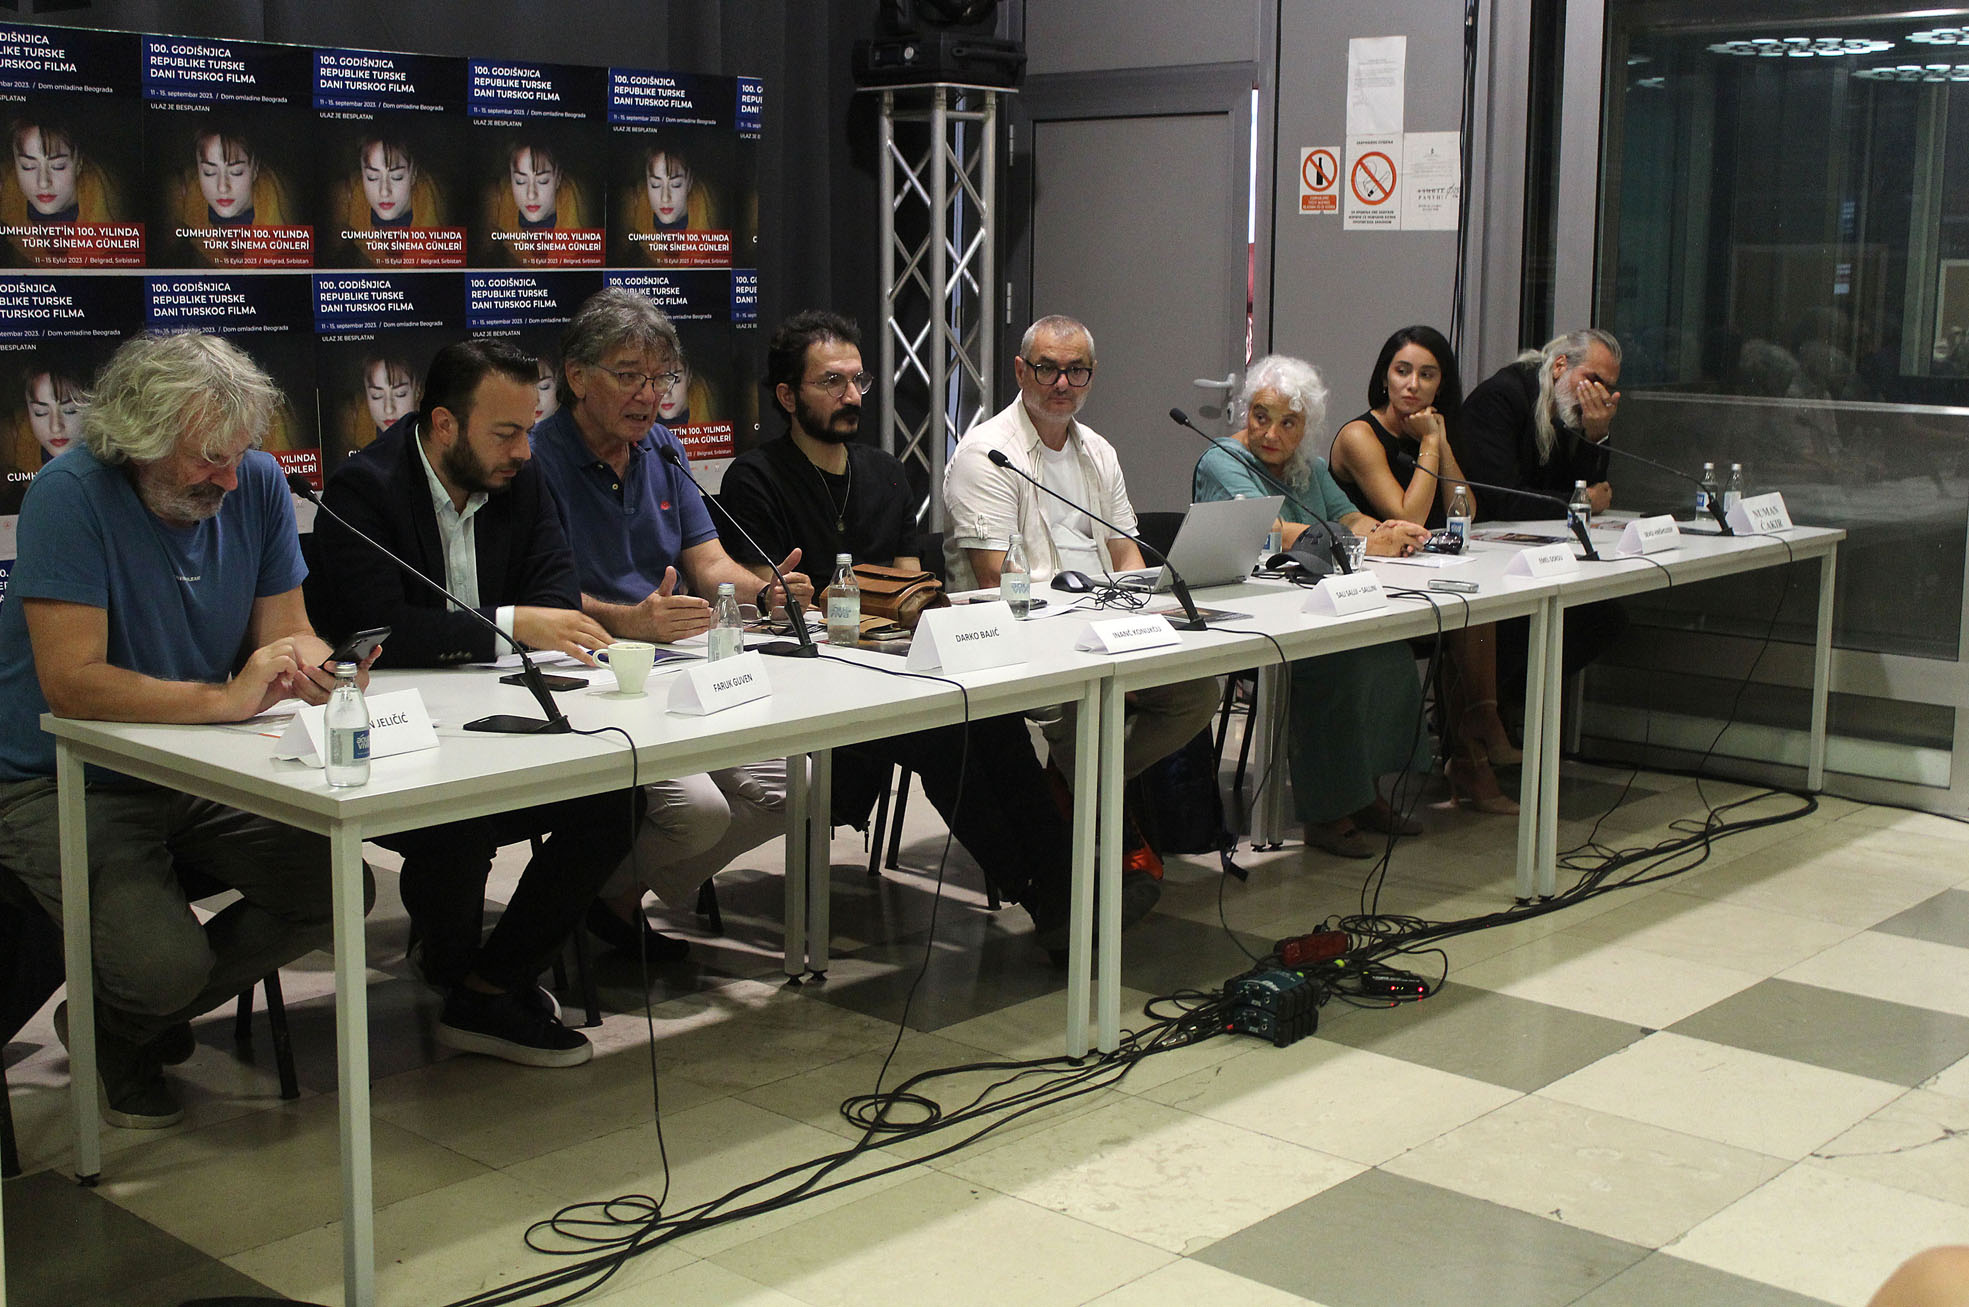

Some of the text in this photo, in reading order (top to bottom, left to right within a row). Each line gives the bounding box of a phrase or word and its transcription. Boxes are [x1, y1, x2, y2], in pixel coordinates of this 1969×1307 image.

[24, 47, 65, 58] TURSKE
[150, 44, 231, 57] 100. GODIŠNJICA
[45, 62, 77, 72] FILMA
[151, 56, 245, 70] REPUBLIKE TURSKE
[320, 56, 394, 69] 100. GODIŠNJICA
[151, 69, 256, 84] DANI TURSKOG FILMA
[320, 68, 406, 81] REPUBLIKE TURSKE
[474, 66, 540, 78] 100. GODIŠNJICA
[320, 80, 415, 93] DANI TURSKOG FILMA
[474, 78, 551, 89] REPUBLIKE TURSKE
[614, 76, 675, 87] 100. GODIŠNJICA
[474, 89, 560, 101] DANI TURSKOG FILMA
[614, 87, 685, 98] REPUBLIKE TURSKE
[614, 97, 633, 105] DANI
[635, 98, 669, 107] TURSKOG
[78, 228, 96, 236] 100.
[99, 228, 139, 236] YILINDA
[176, 228, 309, 239] CUMHURİYET'İN 100. YILINDA
[411, 231, 427, 239] 100.
[22, 237, 139, 248] TÜRK SİNEMA GÜNLERİ
[203, 239, 309, 250] TÜRK SİNEMA GÜNLERİ
[366, 240, 461, 250] TÜRK SİNEMA GÜNLERİ
[514, 241, 601, 250] TÜRK SİNEMA GÜNLERİ
[670, 242, 697, 251] SİNEMA
[699, 242, 729, 251] GÜNLERİ
[320, 279, 391, 289] 100. GODIŠNJICA
[489, 278, 536, 287] GODIŠNJICA
[625, 276, 669, 285] GODIŠNJICA
[152, 282, 230, 292] 100. GODIŠNJICA
[320, 292, 404, 300] REPUBLIKE TURSKE
[472, 290, 516, 298] REPUBLIKE
[32, 297, 72, 305] TURSKE
[153, 295, 245, 304] REPUBLIKE TURSKE
[321, 302, 414, 312] DANI TURSKOG FILMA
[494, 301, 531, 309] TURSKOG
[53, 309, 84, 318] FILMA
[154, 306, 256, 316] DANI TURSKOG FILMA
[701, 434, 731, 443] GÜNLERİ
[281, 453, 316, 463] YILINDA
[955, 627, 1000, 643] DARKO BAJIĆ
[713, 678, 733, 693] FARUK
